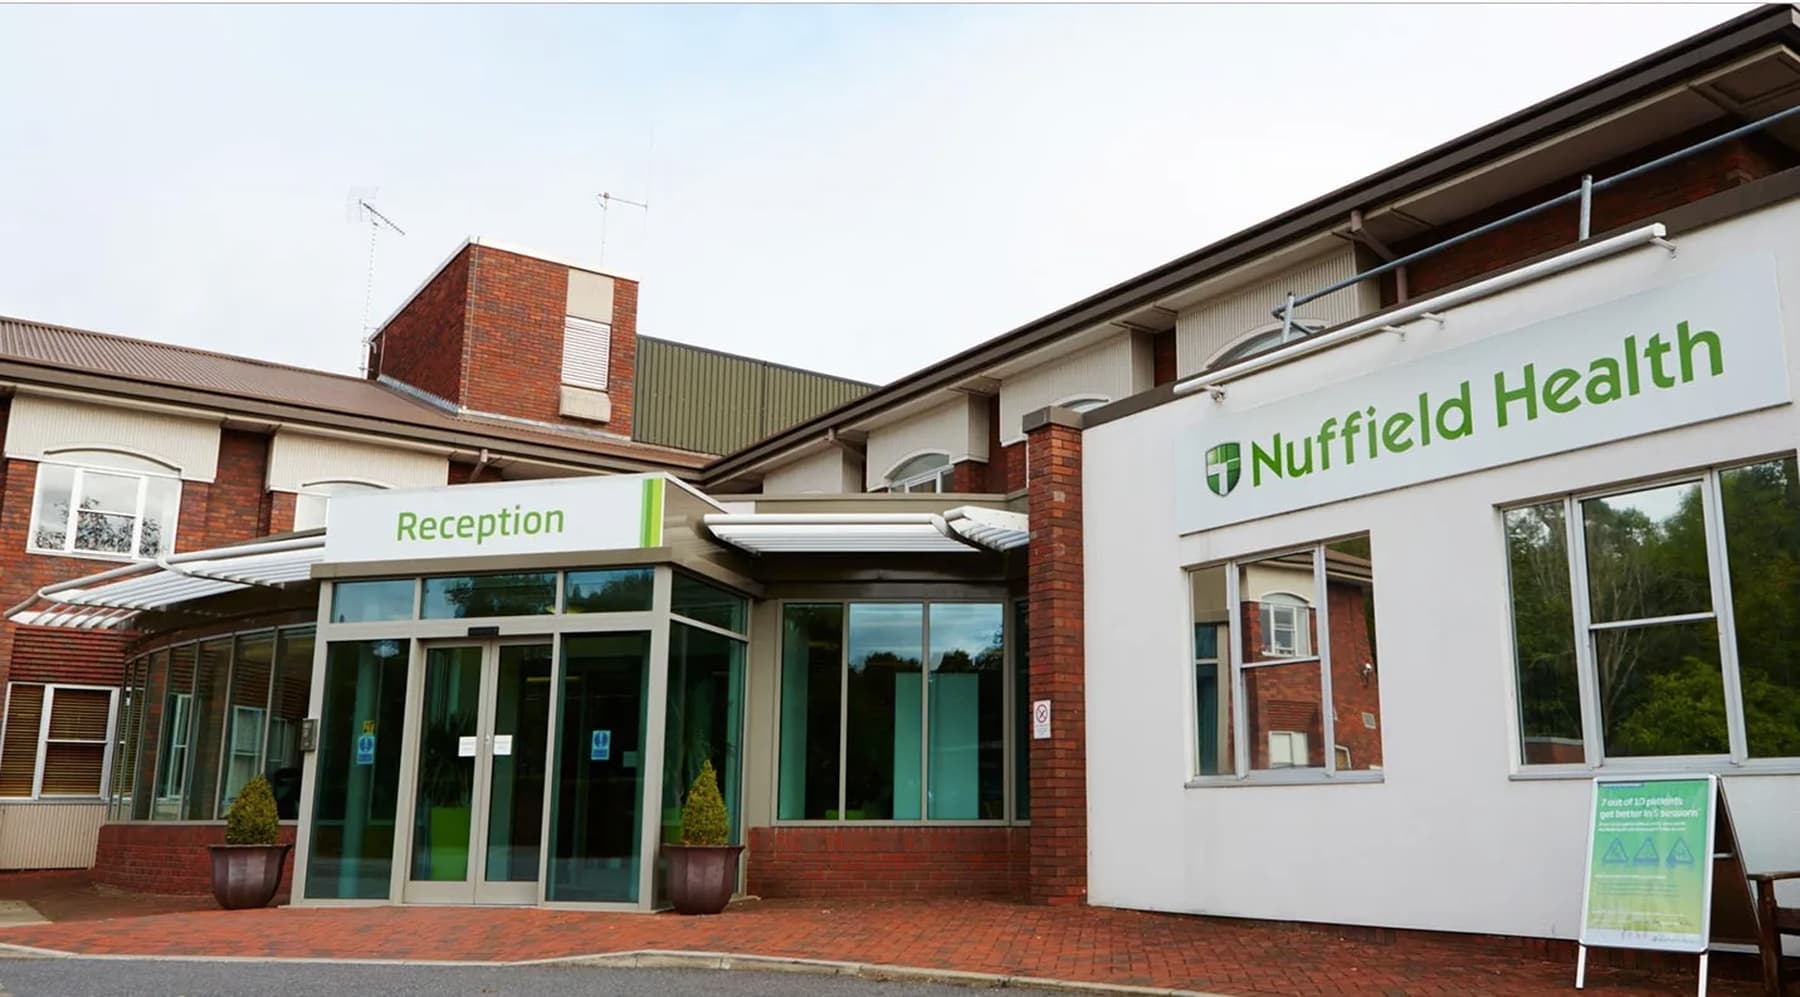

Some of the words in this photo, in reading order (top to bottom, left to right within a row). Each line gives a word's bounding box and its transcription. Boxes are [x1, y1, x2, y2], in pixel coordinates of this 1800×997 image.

[1251, 381, 1473, 487] Nuffield
[1494, 321, 1724, 428] Health
[397, 505, 563, 544] Reception
[1608, 798, 1622, 807] out
[1623, 797, 1633, 806] of
